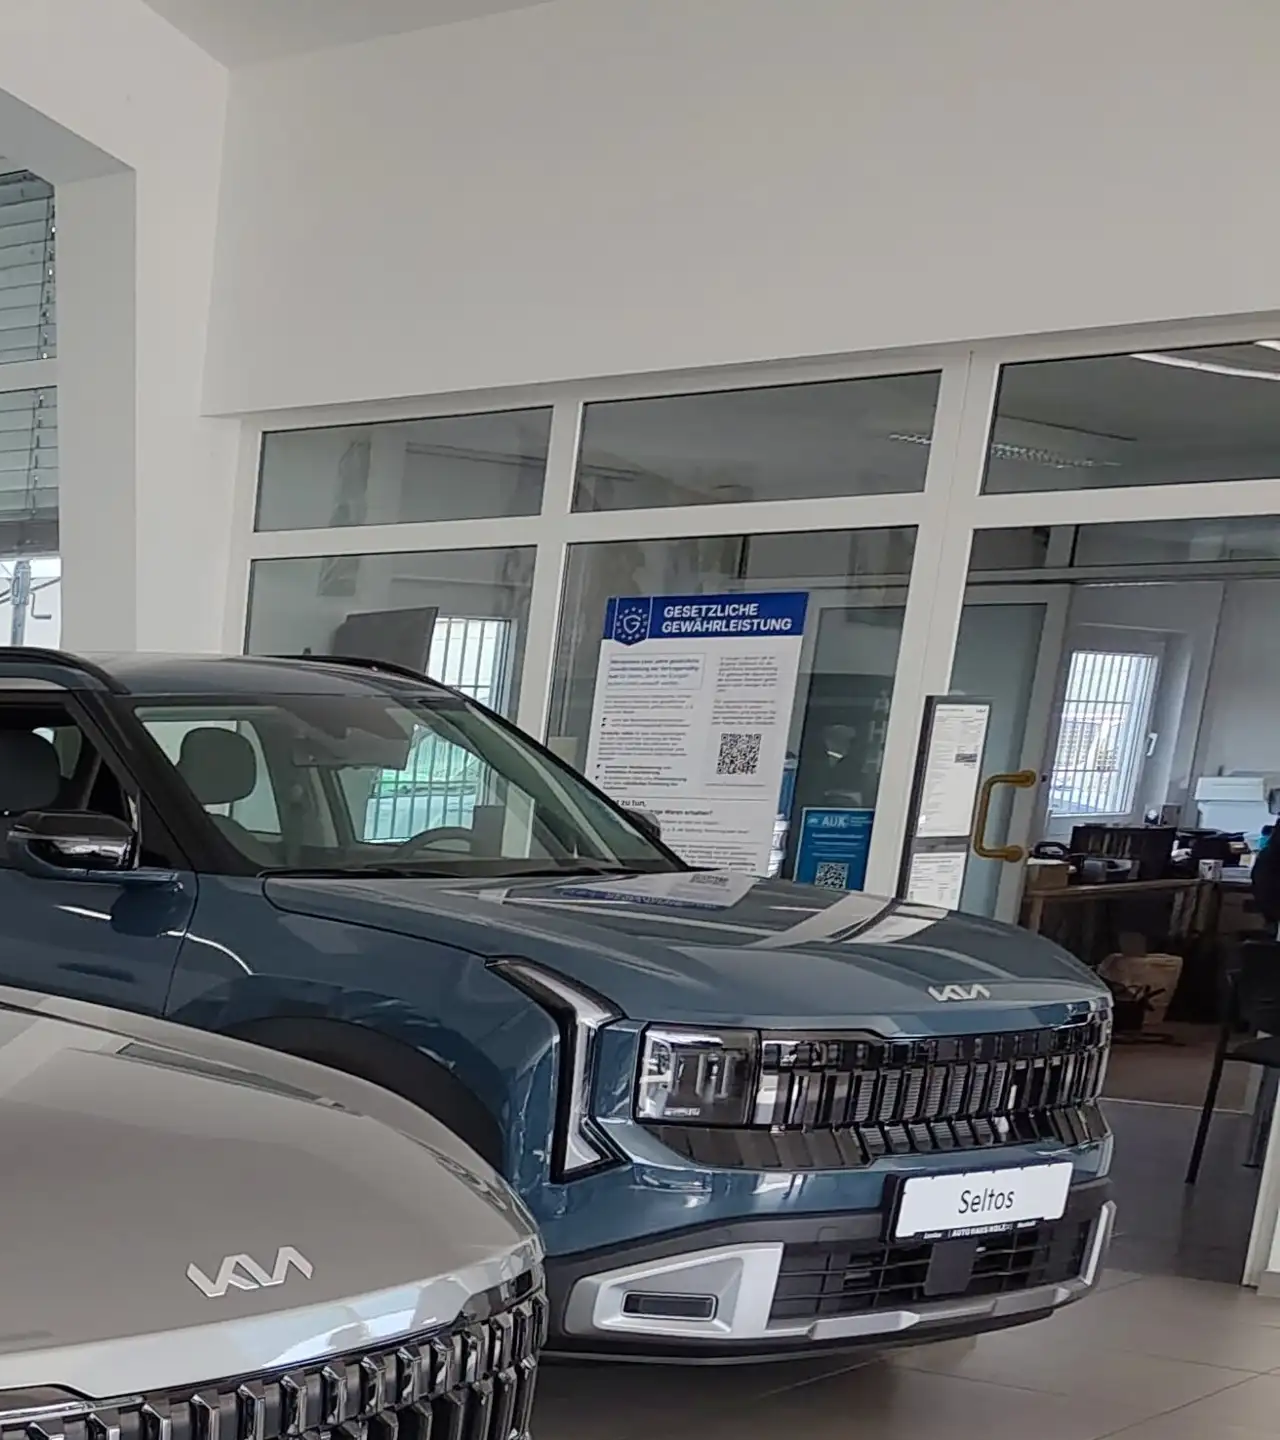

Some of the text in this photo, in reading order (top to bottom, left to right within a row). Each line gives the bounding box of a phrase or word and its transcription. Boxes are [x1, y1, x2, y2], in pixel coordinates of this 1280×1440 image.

[664, 603, 759, 618] GESETZLICHE
[662, 617, 793, 633] GEWÄHRLEISTUNG
[958, 1188, 1015, 1214] Seltos
